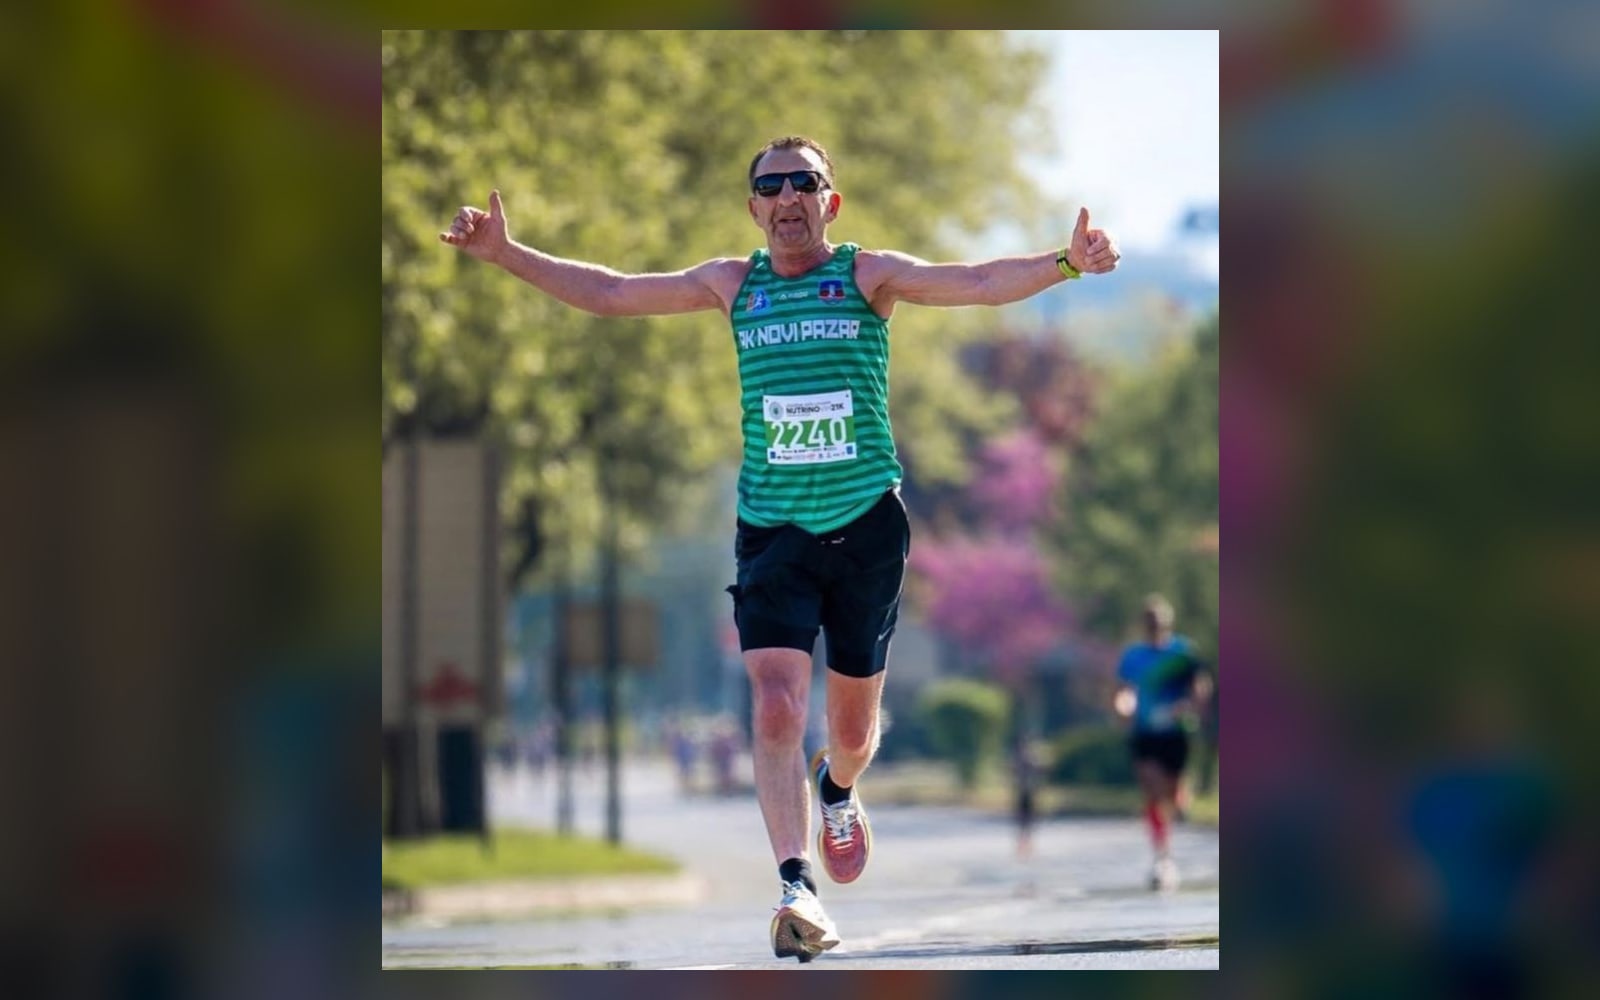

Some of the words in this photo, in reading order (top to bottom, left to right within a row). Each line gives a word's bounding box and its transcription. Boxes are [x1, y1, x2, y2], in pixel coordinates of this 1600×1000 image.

[757, 323, 798, 345] NOVI
[800, 319, 860, 340] PAZAR
[786, 406, 820, 414] NUTRINO
[831, 402, 845, 411] 21K
[771, 418, 846, 448] 2240
